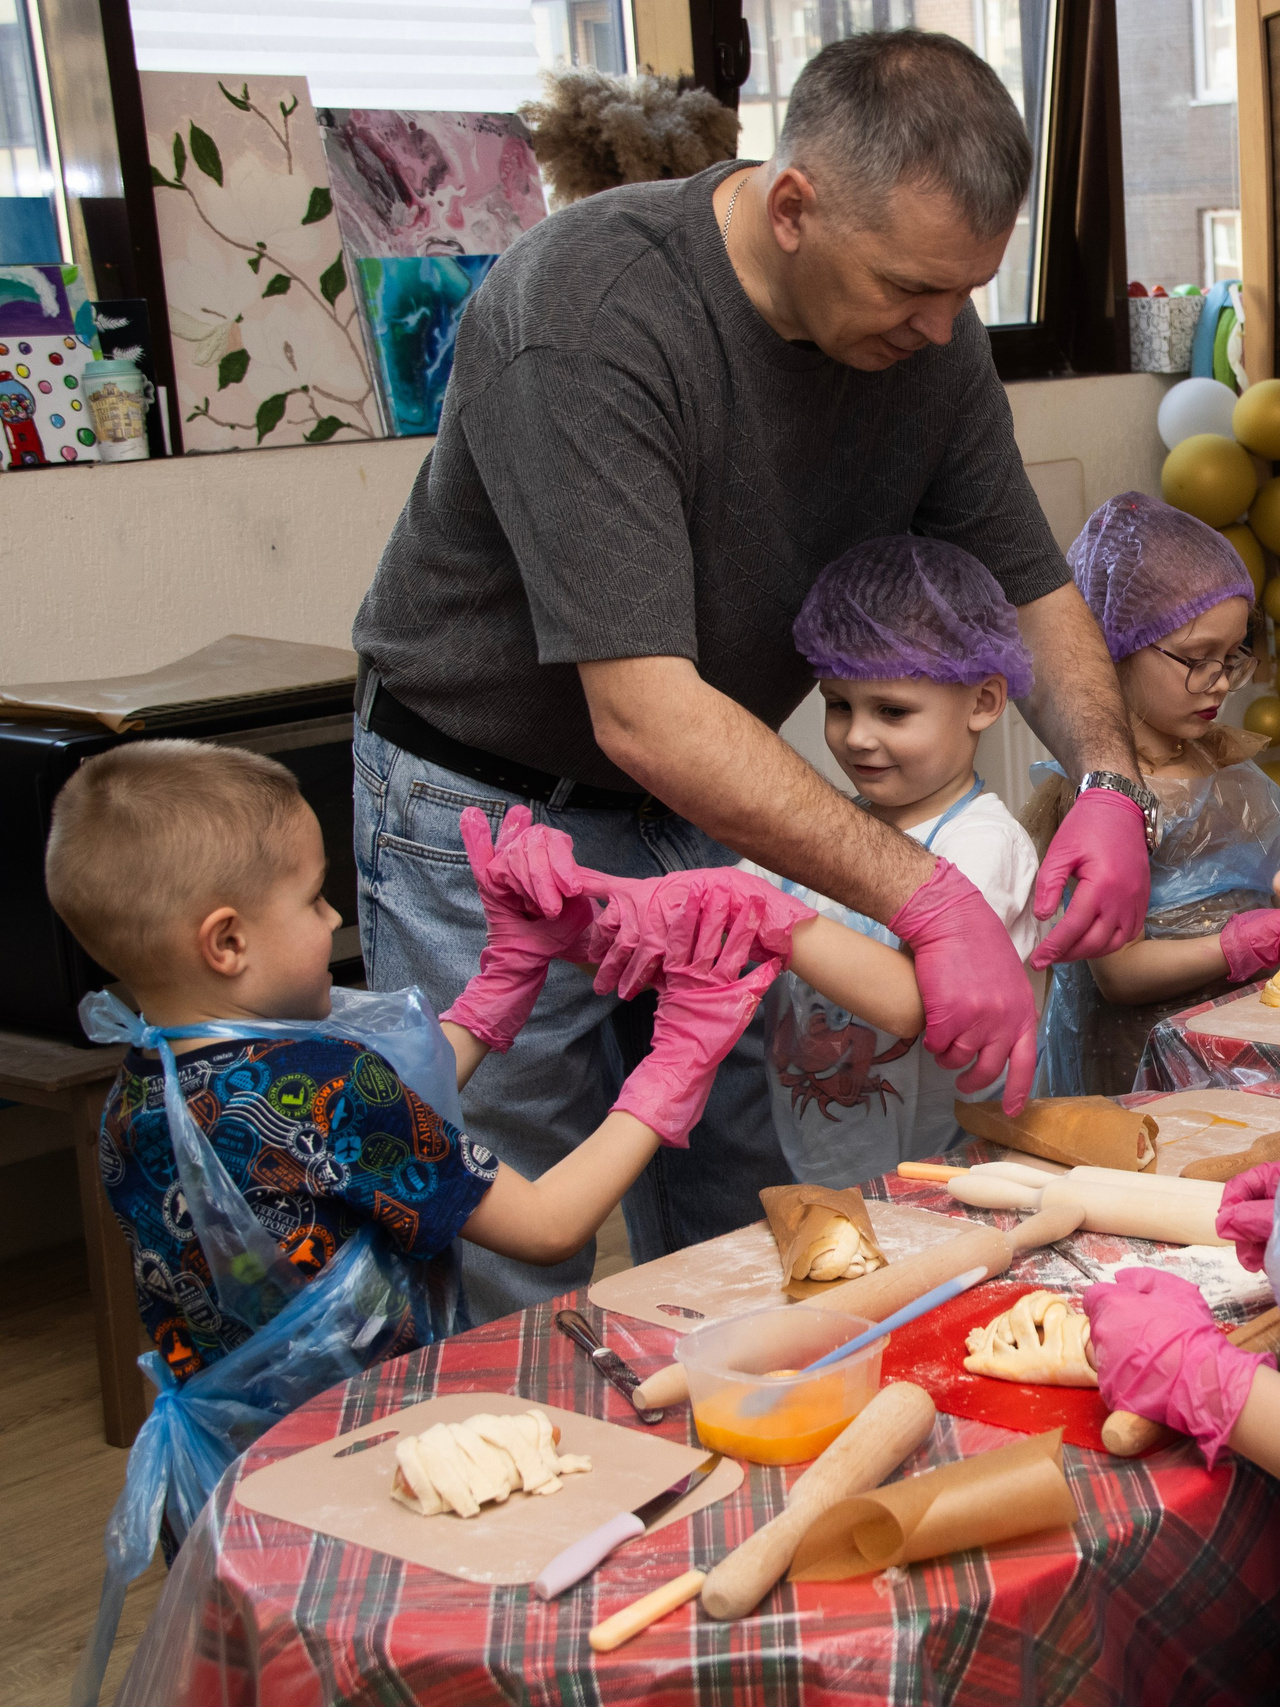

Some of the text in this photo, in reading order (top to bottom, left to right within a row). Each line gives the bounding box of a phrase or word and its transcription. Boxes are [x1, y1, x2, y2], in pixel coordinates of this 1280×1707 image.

[164, 1210, 194, 1239] MOSCOW
[253, 1205, 296, 1227] ARRIVAL
[255, 1213, 293, 1236] IRPORT
